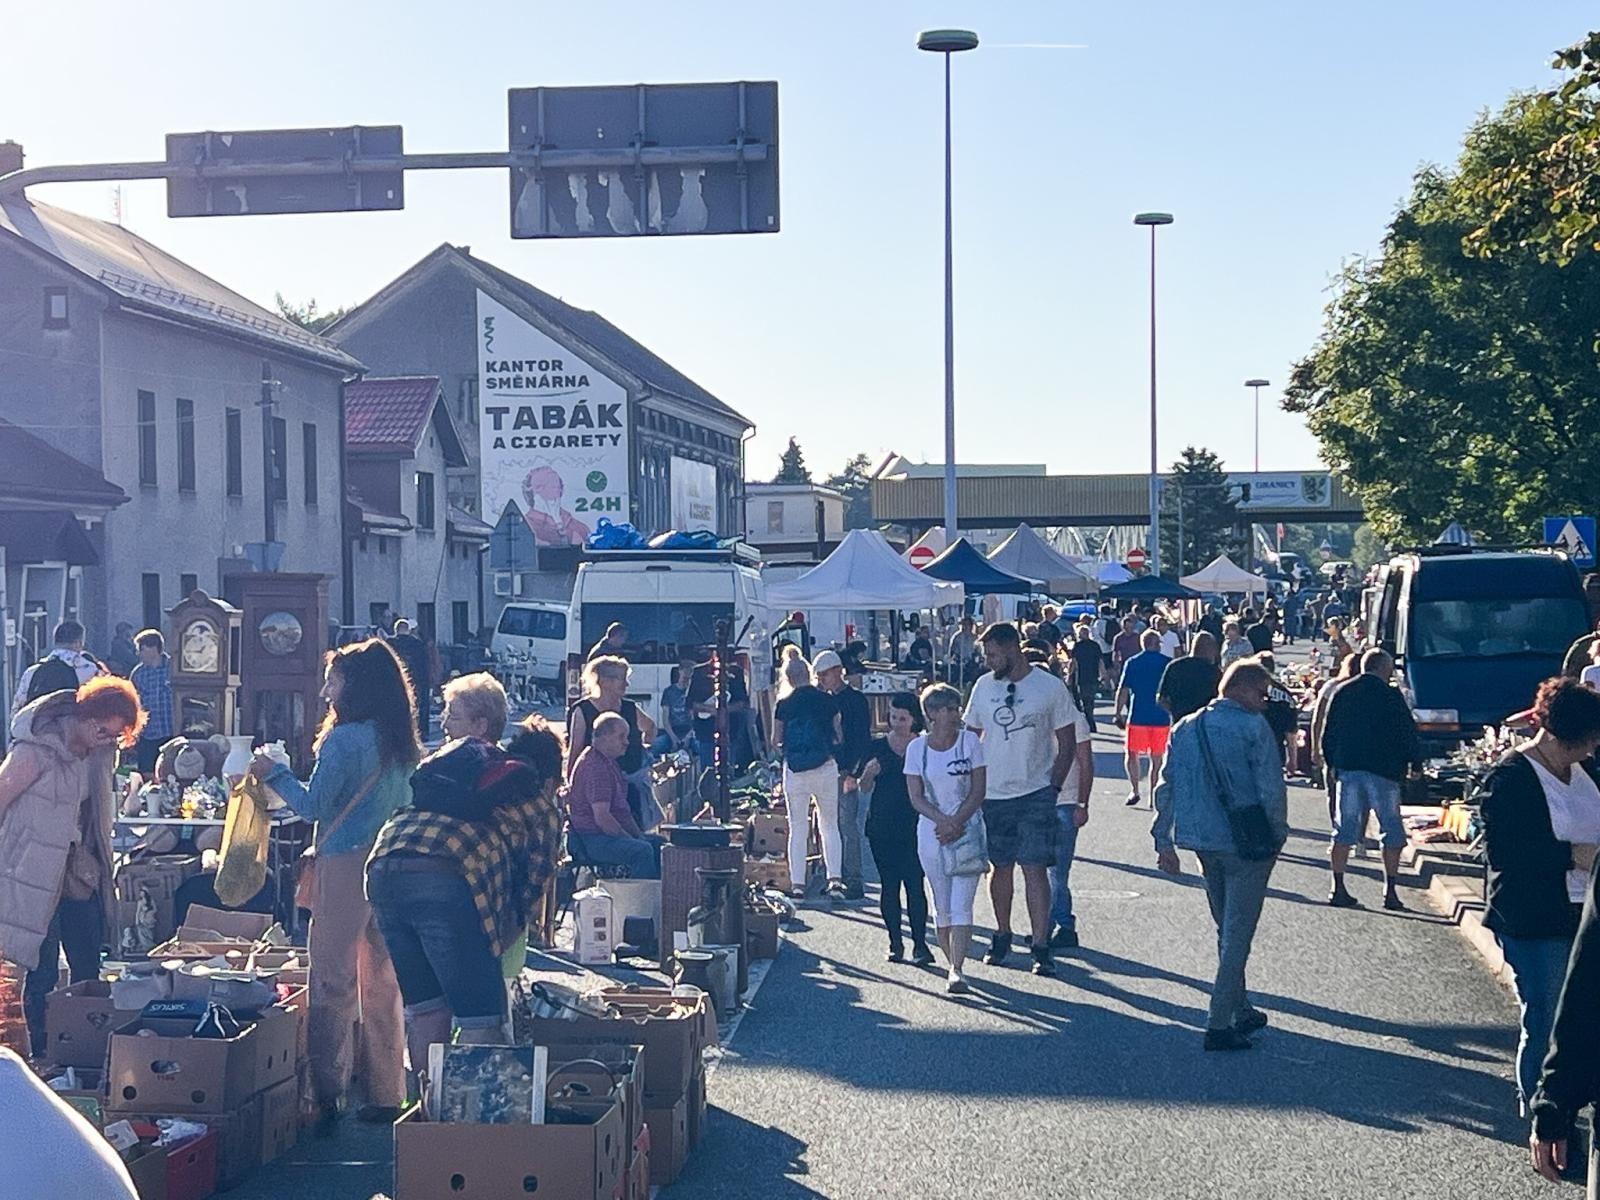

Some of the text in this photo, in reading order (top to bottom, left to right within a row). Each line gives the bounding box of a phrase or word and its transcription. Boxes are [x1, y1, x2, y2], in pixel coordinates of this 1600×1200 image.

[486, 359, 563, 373] KANTOR
[486, 374, 590, 389] SMĚNÁRNA
[485, 399, 623, 430] TABÁK
[493, 433, 621, 449] A CIGARETY
[575, 496, 621, 512] 24H
